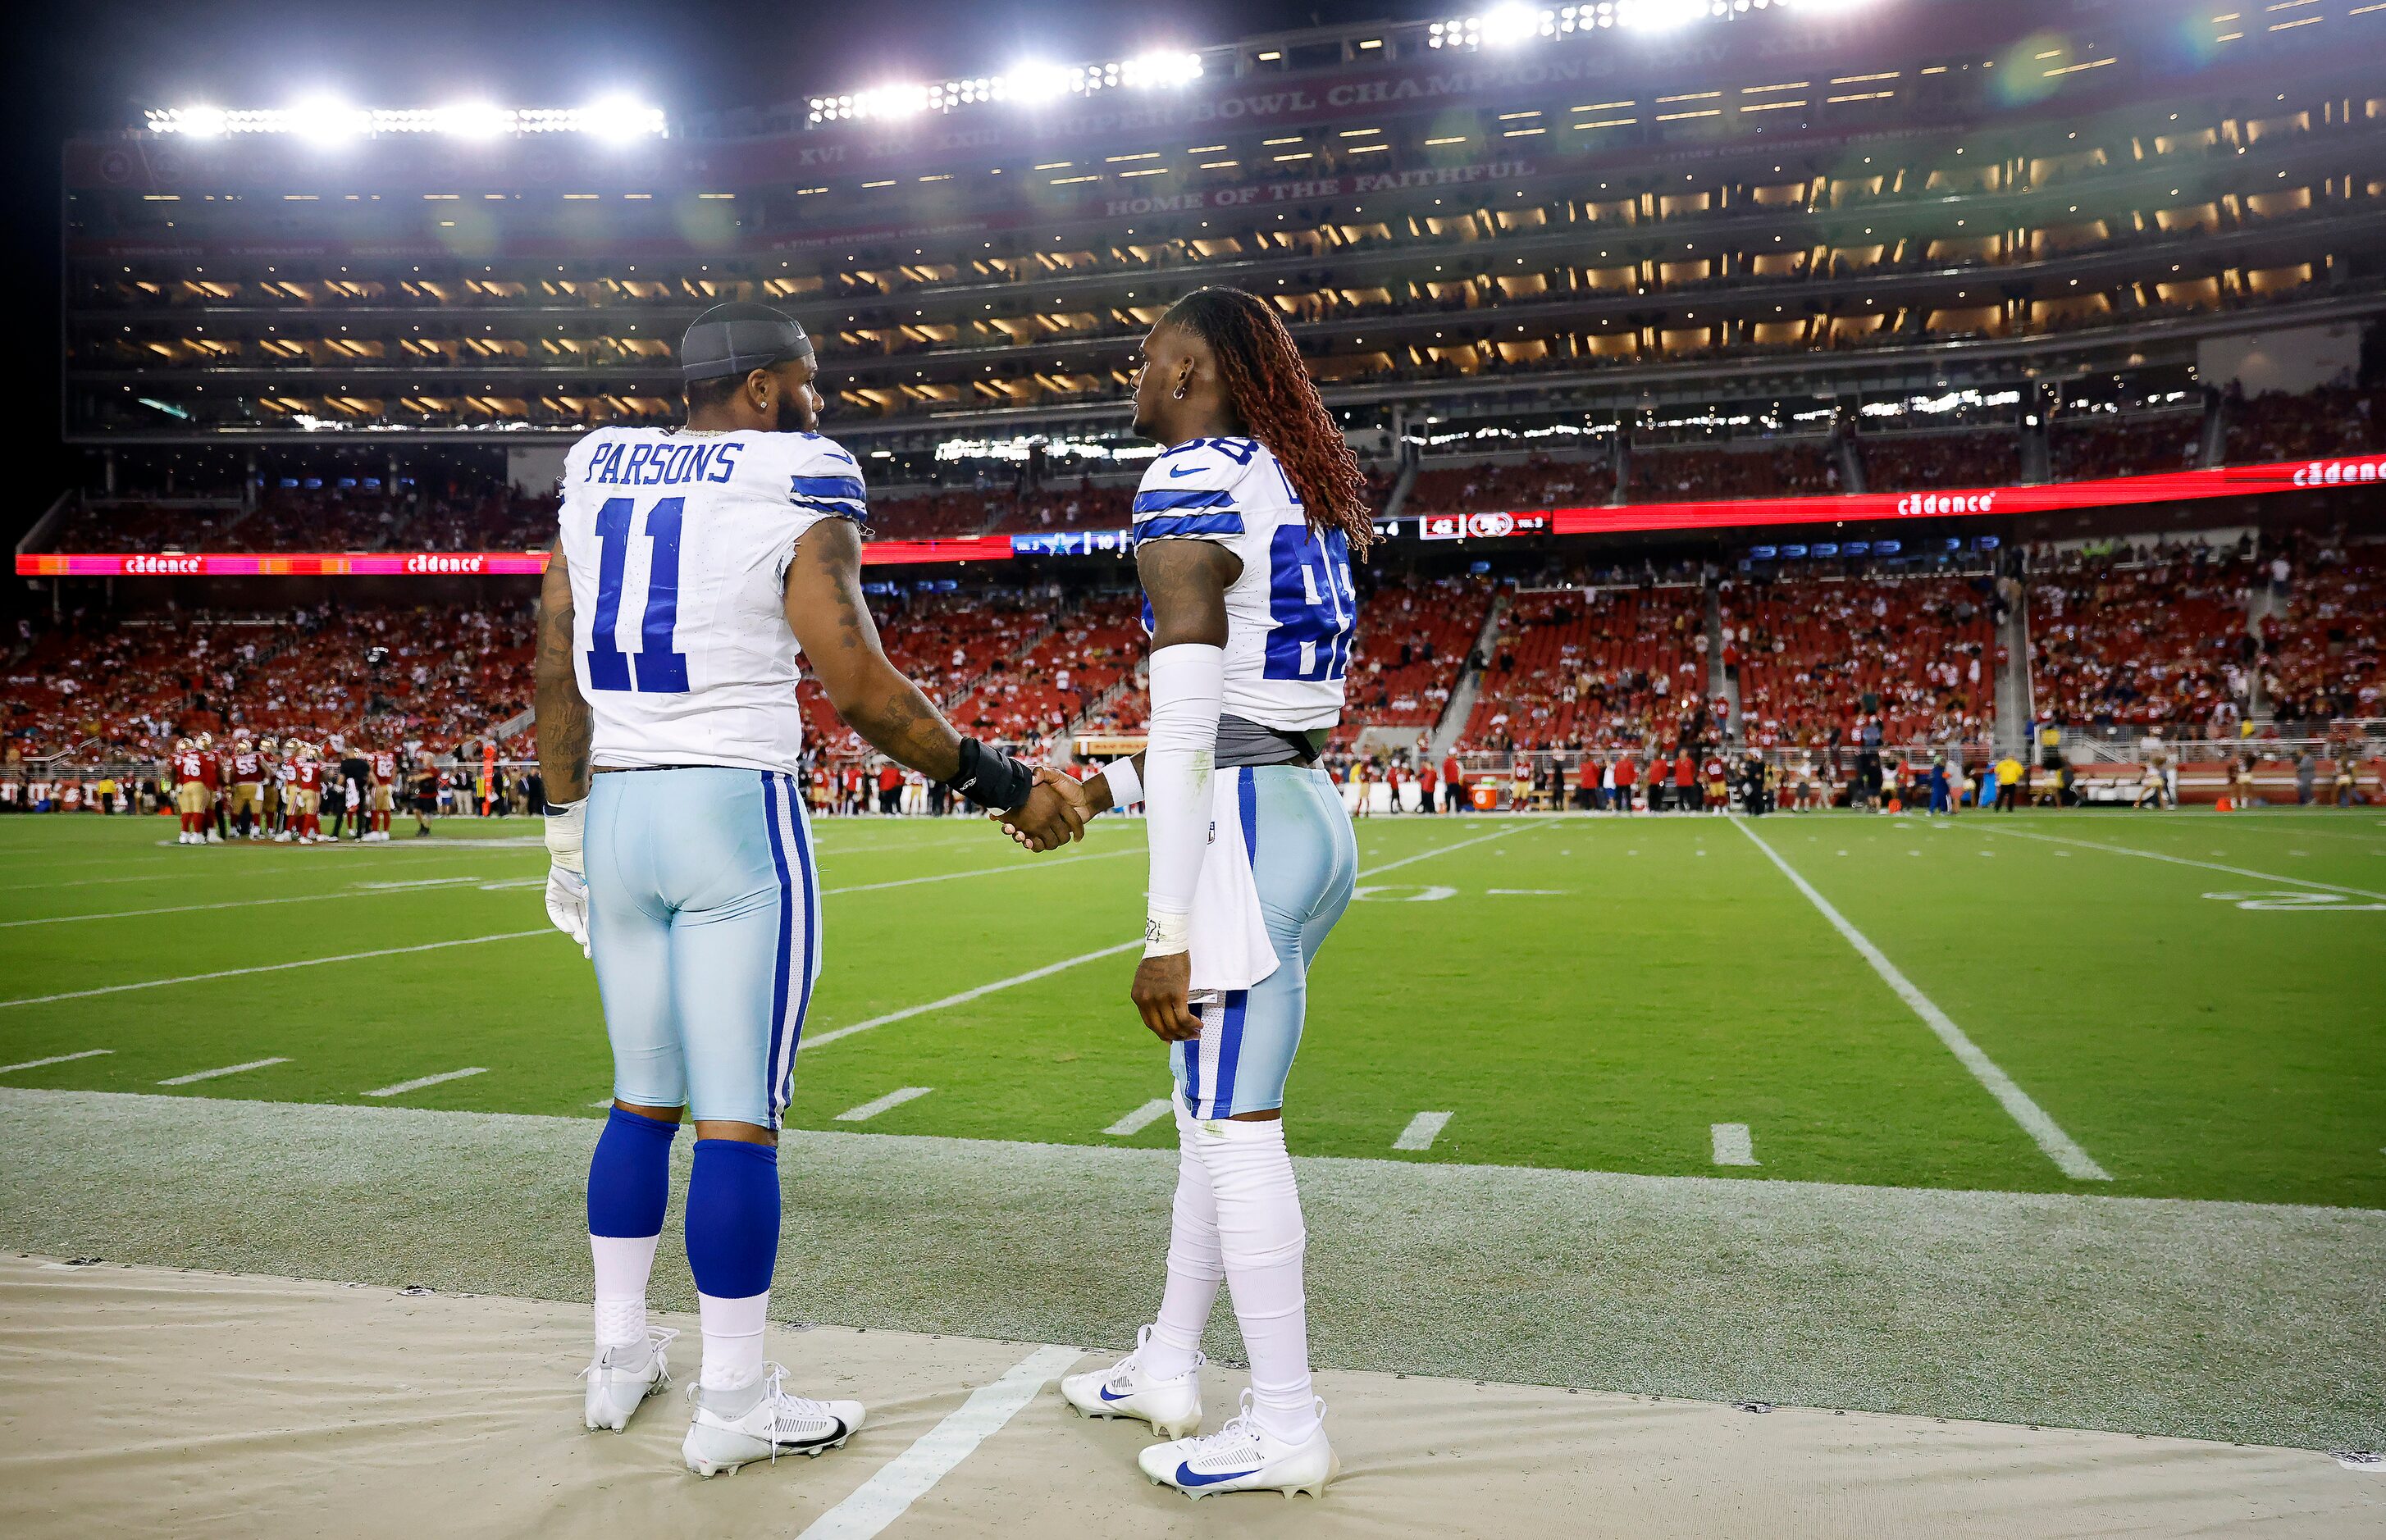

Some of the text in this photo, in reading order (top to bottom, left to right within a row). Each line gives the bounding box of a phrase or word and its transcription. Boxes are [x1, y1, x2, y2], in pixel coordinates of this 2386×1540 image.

[1192, 90, 1316, 123] BOWL
[1327, 54, 1614, 107] CHAMPIONS
[1106, 159, 1537, 217] HOME OF THE FAITHFUL
[583, 443, 745, 485] PARSONS
[1097, 535, 1115, 550] 10
[1431, 519, 1453, 534] 42
[586, 496, 691, 693] 11
[301, 767, 313, 783] 3
